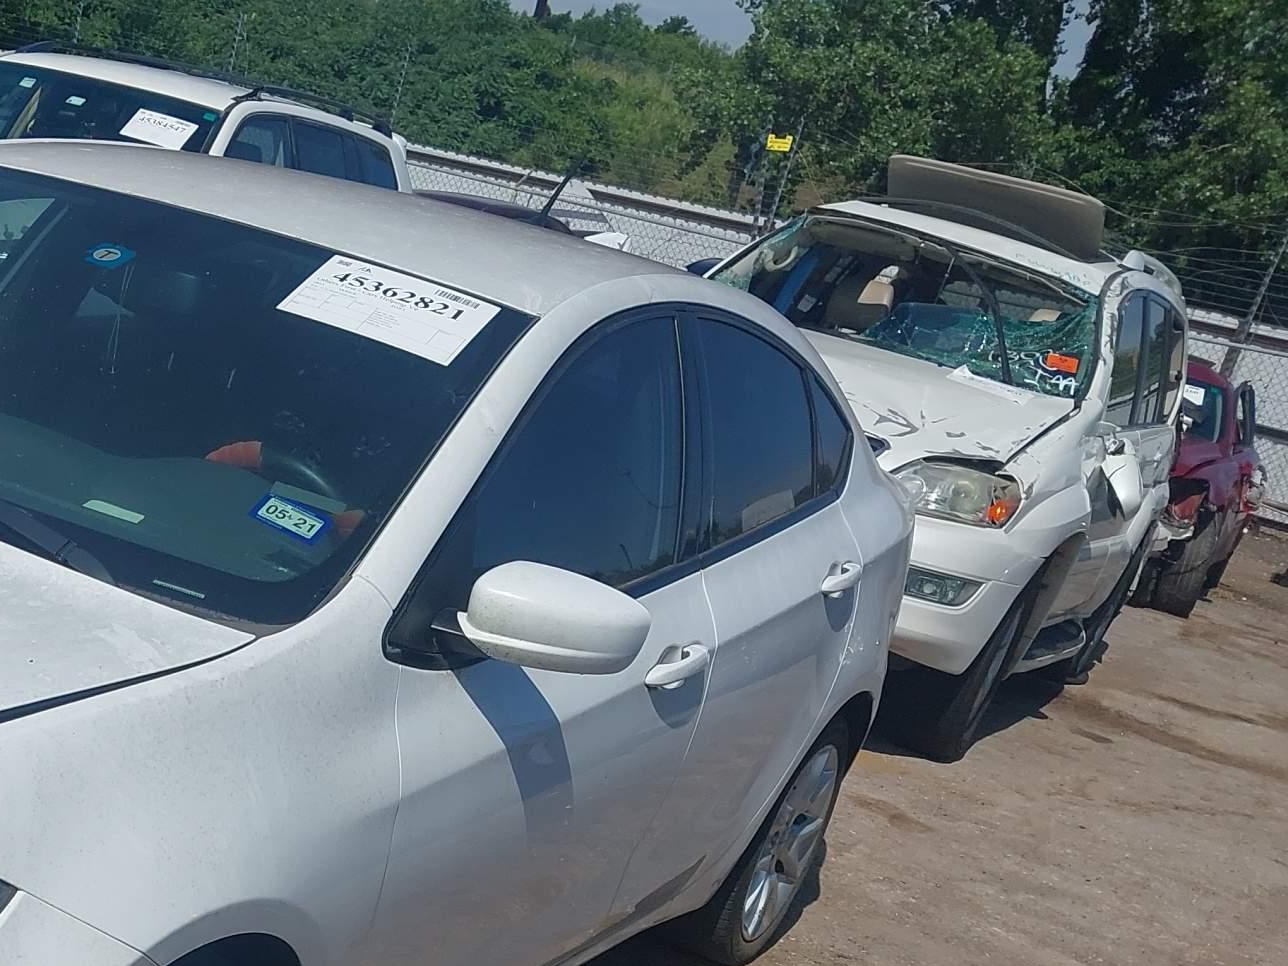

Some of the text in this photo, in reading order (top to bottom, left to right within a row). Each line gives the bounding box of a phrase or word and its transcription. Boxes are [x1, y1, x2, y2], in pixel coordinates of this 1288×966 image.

[333, 272, 466, 322] 45362821
[265, 504, 289, 520] 05
[293, 517, 317, 533] 21
